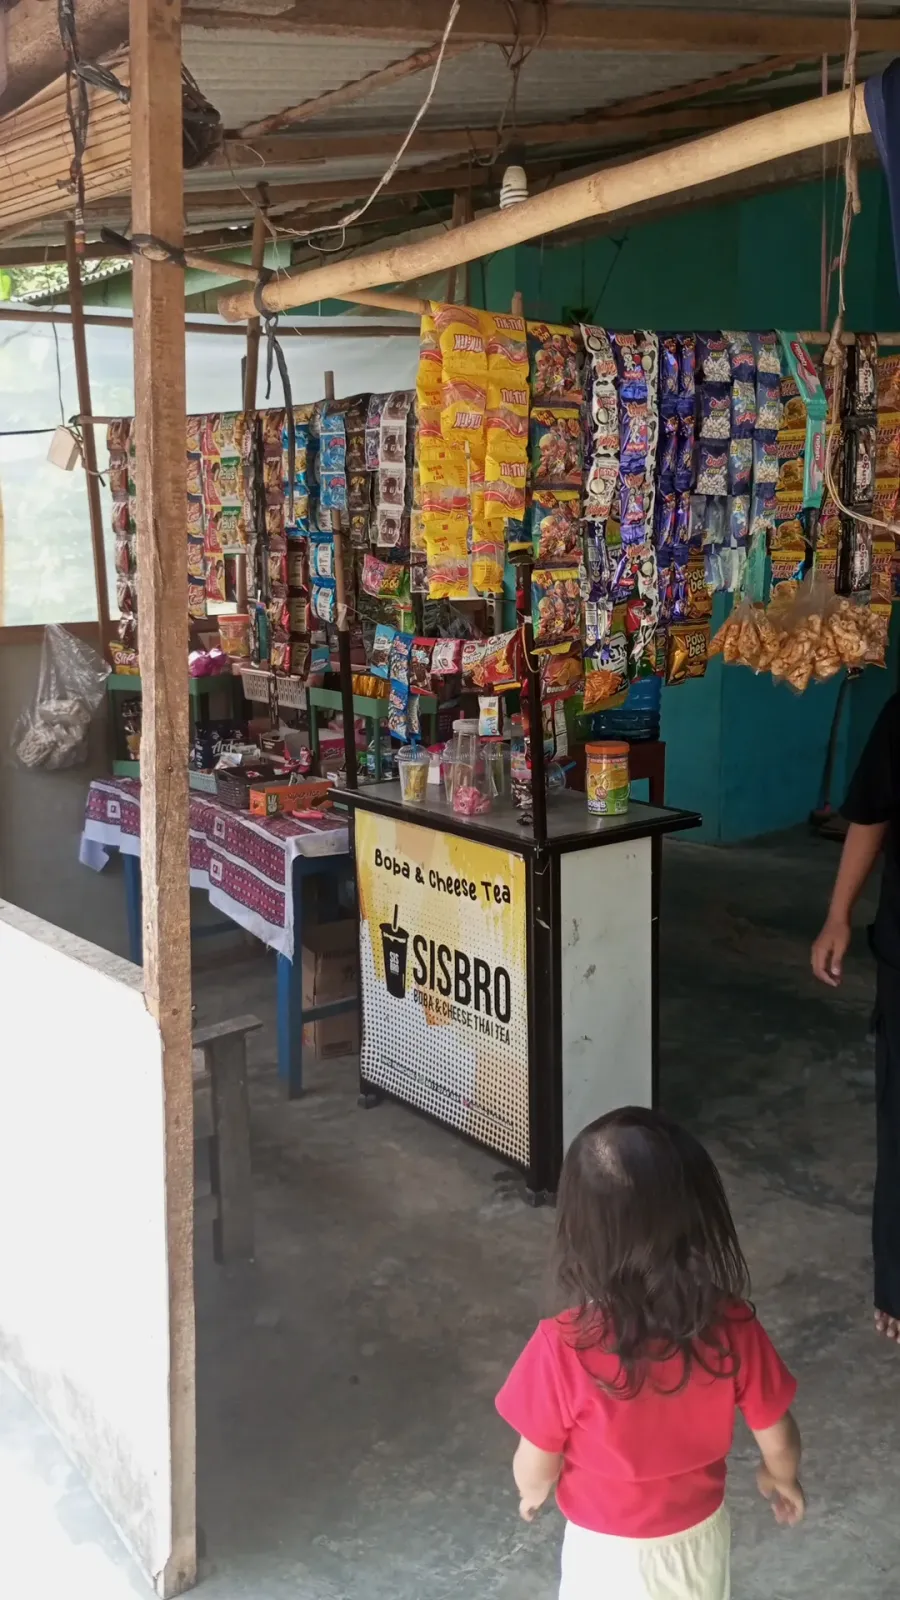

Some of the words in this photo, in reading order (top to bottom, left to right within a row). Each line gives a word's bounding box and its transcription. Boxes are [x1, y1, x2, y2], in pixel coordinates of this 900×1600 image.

[688, 644, 707, 658] bee
[375, 848, 410, 879] Boba
[415, 866, 425, 885] &
[428, 869, 477, 901] Cheese
[480, 880, 511, 904] Tea
[412, 933, 511, 1024] SISBRO
[413, 988, 435, 1012] BOBA
[442, 1000, 473, 1030] CHEESE
[473, 1013, 494, 1039] THAI
[495, 1023, 511, 1046] TEA
